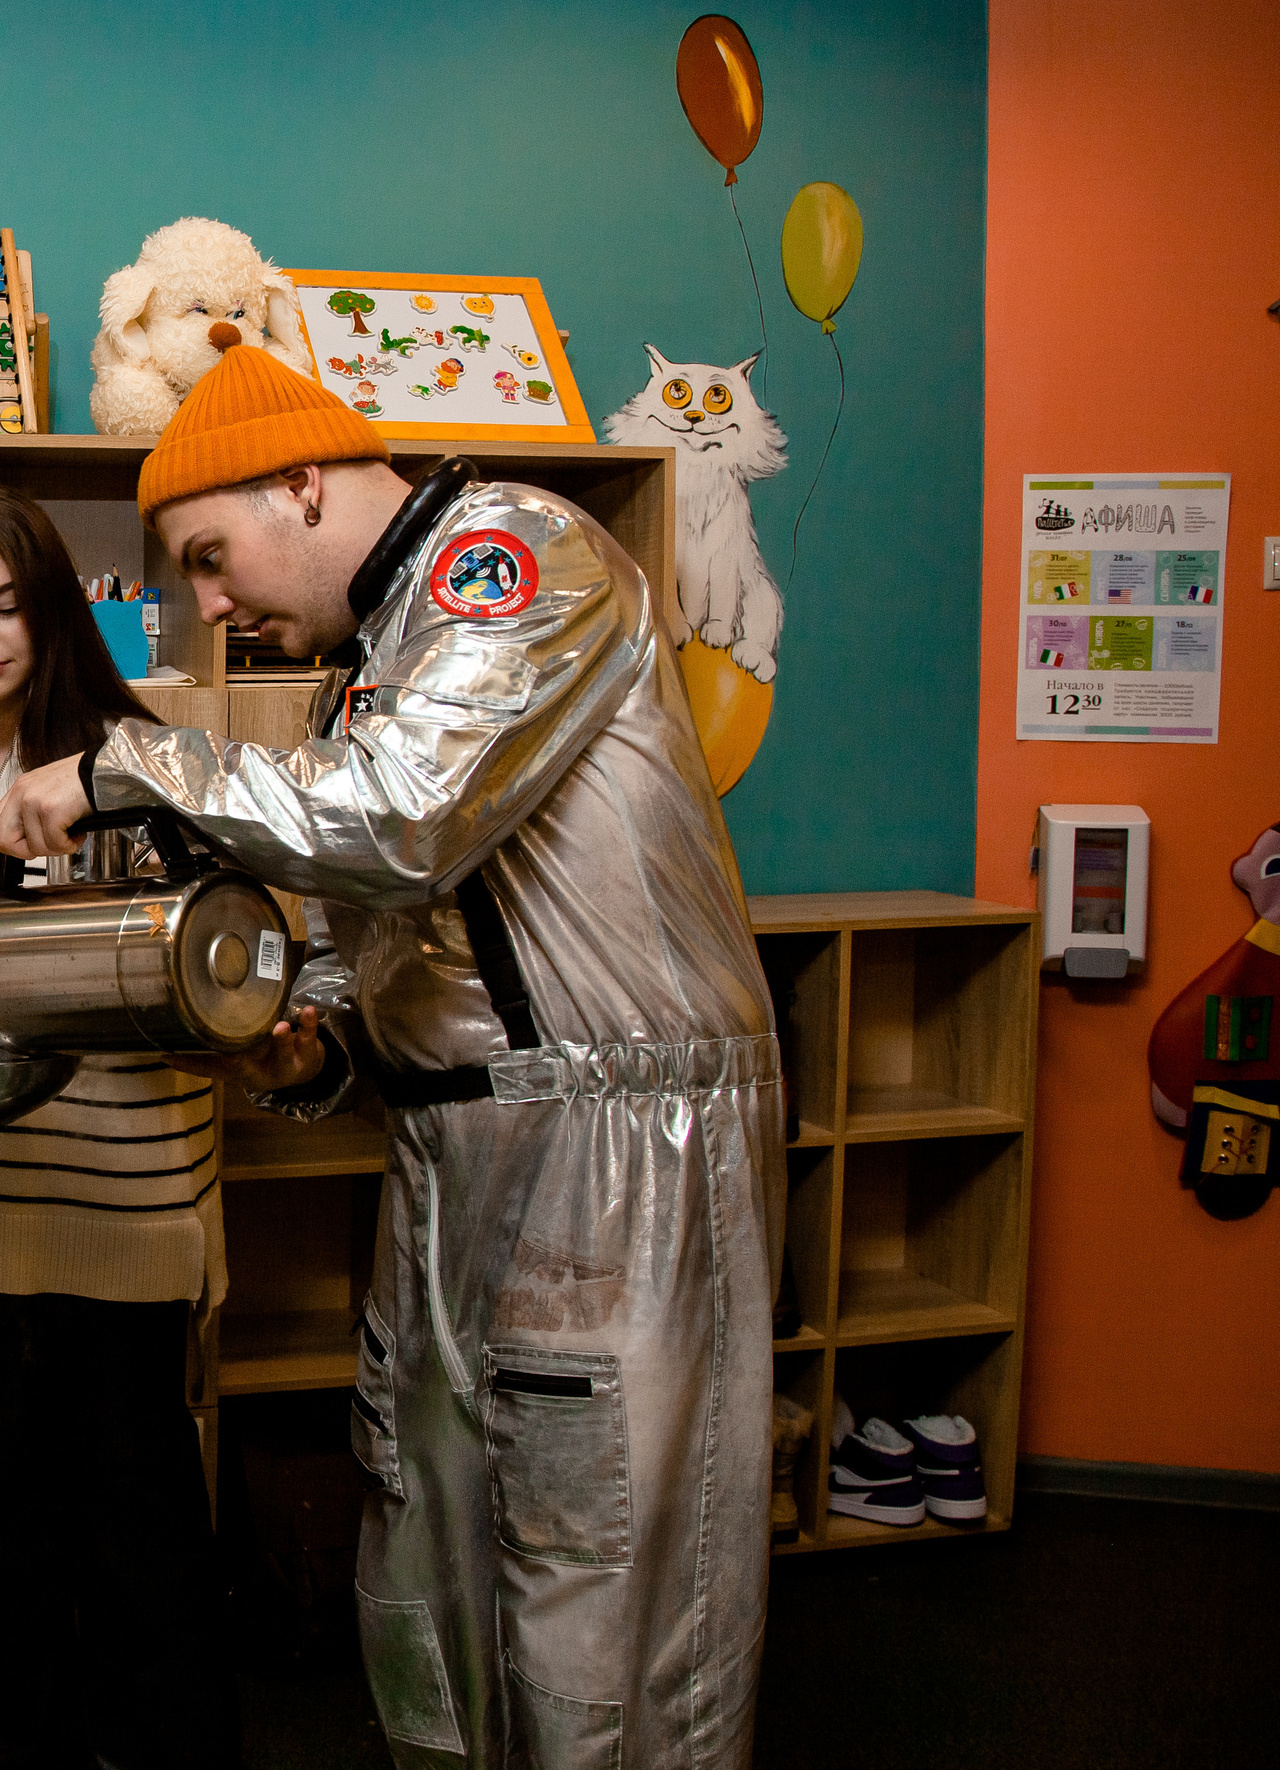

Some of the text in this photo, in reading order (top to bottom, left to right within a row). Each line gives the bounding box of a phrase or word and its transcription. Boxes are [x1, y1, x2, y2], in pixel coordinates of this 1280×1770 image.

[1081, 503, 1176, 535] АФИША
[437, 587, 524, 615] SATELLITE PROJECT
[1046, 680, 1095, 691] Начало
